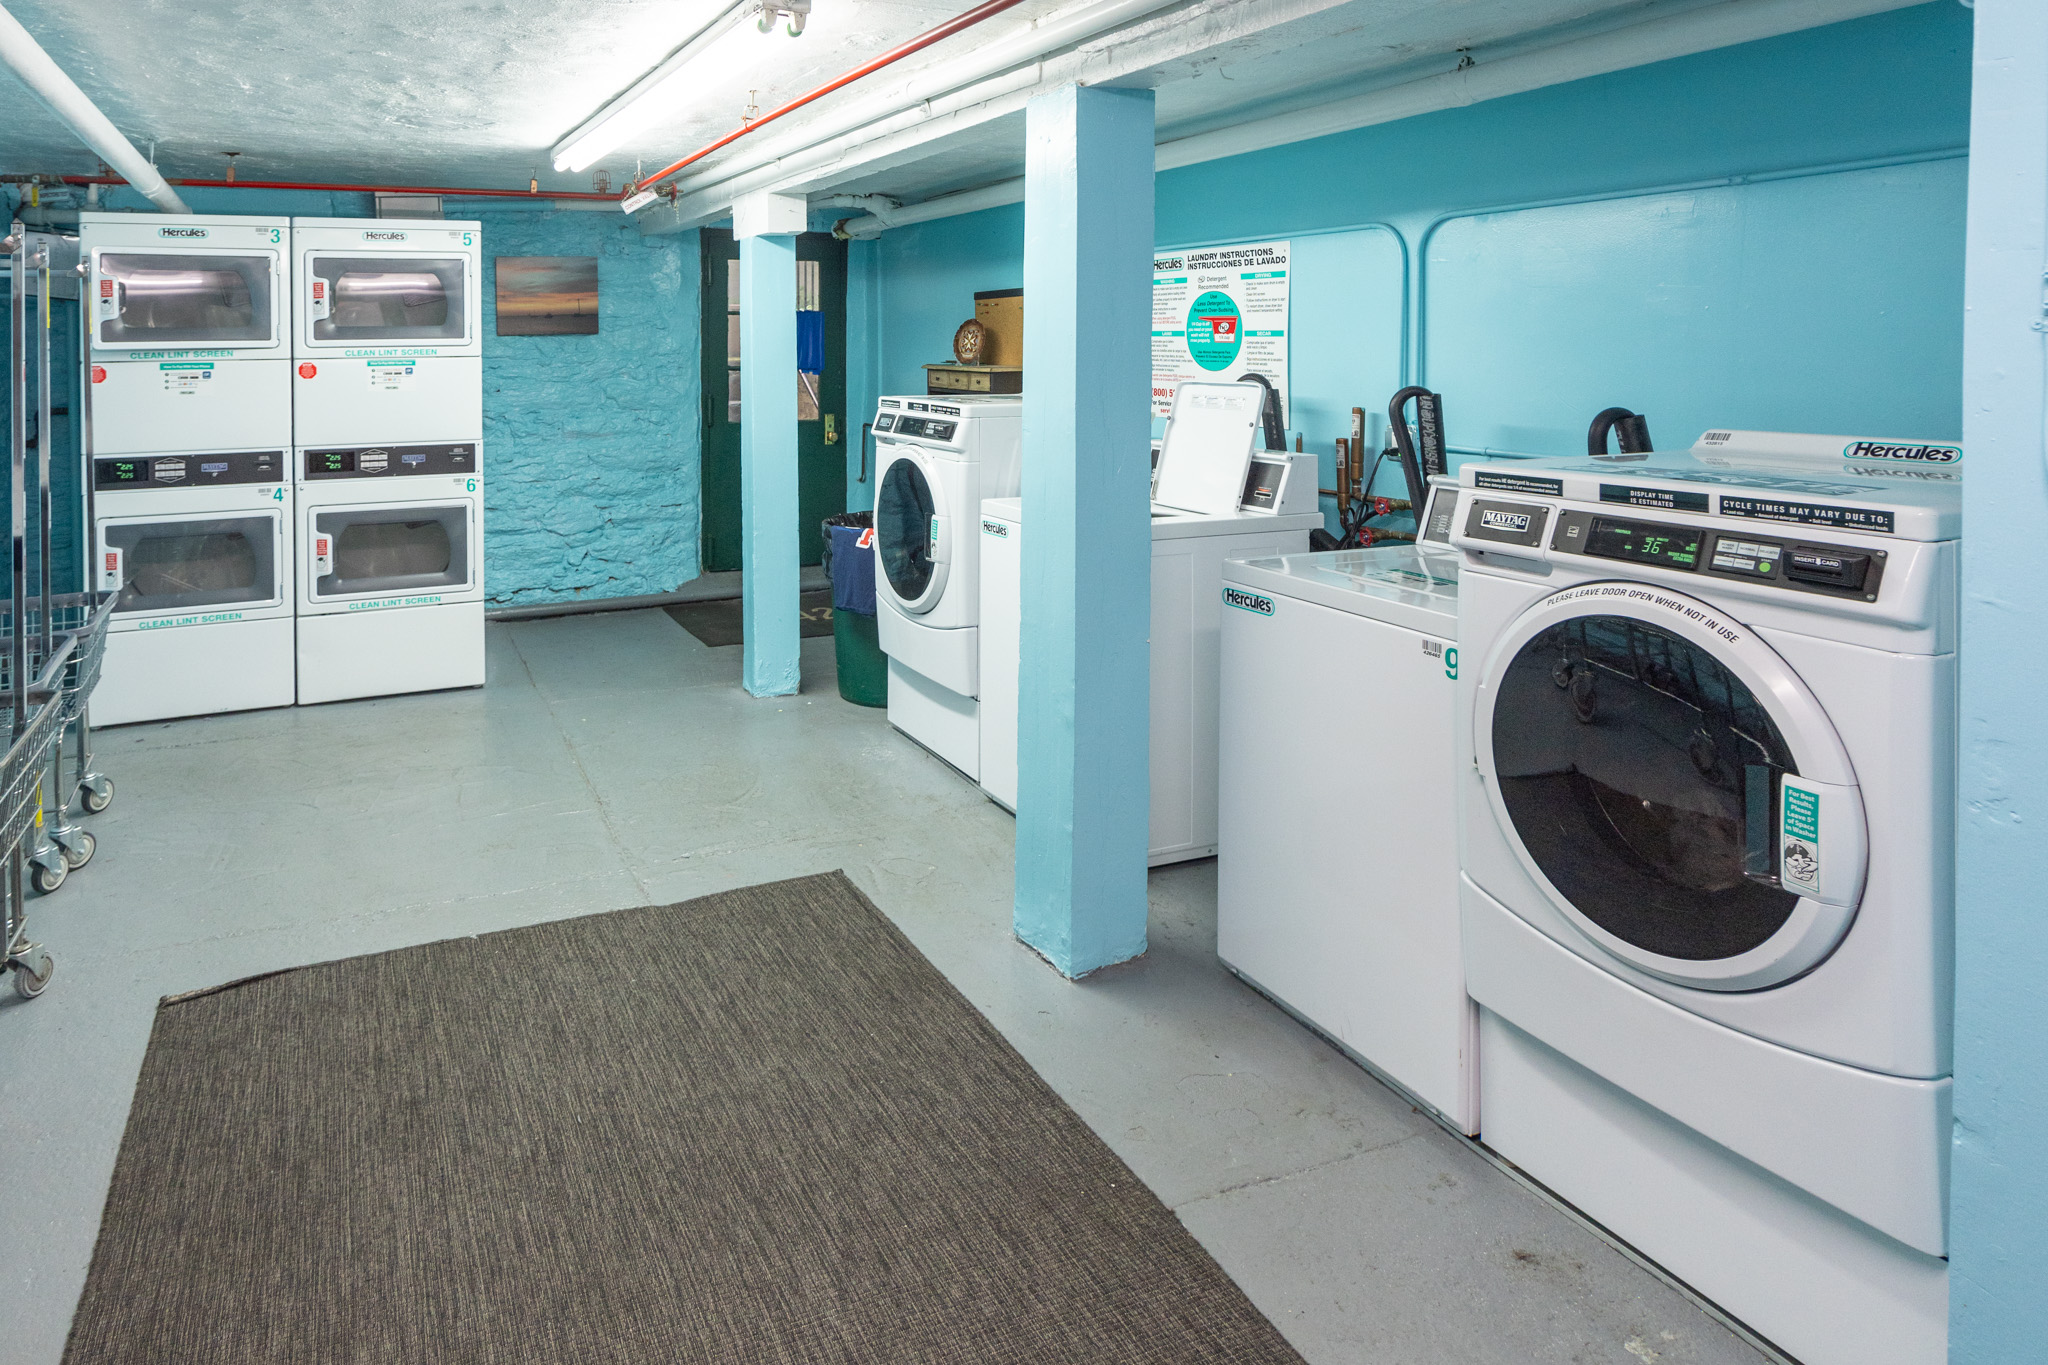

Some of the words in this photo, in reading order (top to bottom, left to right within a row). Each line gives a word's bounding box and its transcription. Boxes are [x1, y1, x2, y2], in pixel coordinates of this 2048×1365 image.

[162, 228, 206, 238] Hercules
[270, 228, 280, 244] 3
[366, 232, 405, 240] Hercules
[463, 232, 472, 246] 5
[1187, 252, 1217, 262] LAUNDRY
[1219, 248, 1273, 259] INSTRUCTIONS
[1187, 260, 1242, 270] INSTRUCCIONES
[1256, 256, 1286, 266] LAVADO
[130, 352, 164, 360] CLEAN
[193, 350, 234, 358] SCREEN
[1852, 442, 1954, 461] Hercules
[466, 478, 476, 492] 6
[273, 488, 283, 501] 4
[1630, 490, 1656, 499] DISPLAY
[1659, 492, 1674, 500] TIME
[1640, 498, 1674, 508] ESTIMATED
[1485, 512, 1526, 526] MAYTAG
[1724, 500, 1752, 509] CYCLE
[1756, 503, 1785, 513] TIMES
[1789, 507, 1810, 515] MAY
[1814, 510, 1840, 518] VARY
[1845, 512, 1865, 521] DUE
[1870, 515, 1888, 524] TO:
[983, 521, 1007, 536] Hercules
[1642, 541, 1662, 554] 36
[349, 601, 380, 610] CLEAN
[383, 599, 402, 607] LINT
[405, 596, 441, 605] SCREEN
[1226, 589, 1272, 612] Hercules
[139, 620, 173, 630] CLEAN
[176, 617, 198, 625] LINT
[202, 612, 242, 623] SCREEN
[1547, 592, 1573, 606] PLEASE
[1575, 588, 1600, 598] LEAVE
[1602, 588, 1627, 596] DOOR
[1628, 590, 1654, 602] OPEN
[1655, 596, 1683, 612] WHEN
[1683, 607, 1707, 622] NOT
[1705, 619, 1718, 630] IN
[1717, 626, 1740, 644] USE
[1445, 647, 1458, 680] 9
[1788, 789, 1800, 798] For
[1800, 792, 1815, 802] Best
[1787, 810, 1806, 821] Leave
[1790, 804, 1812, 815] Please
[1793, 826, 1816, 839] Washer
[1795, 820, 1815, 832] Space
